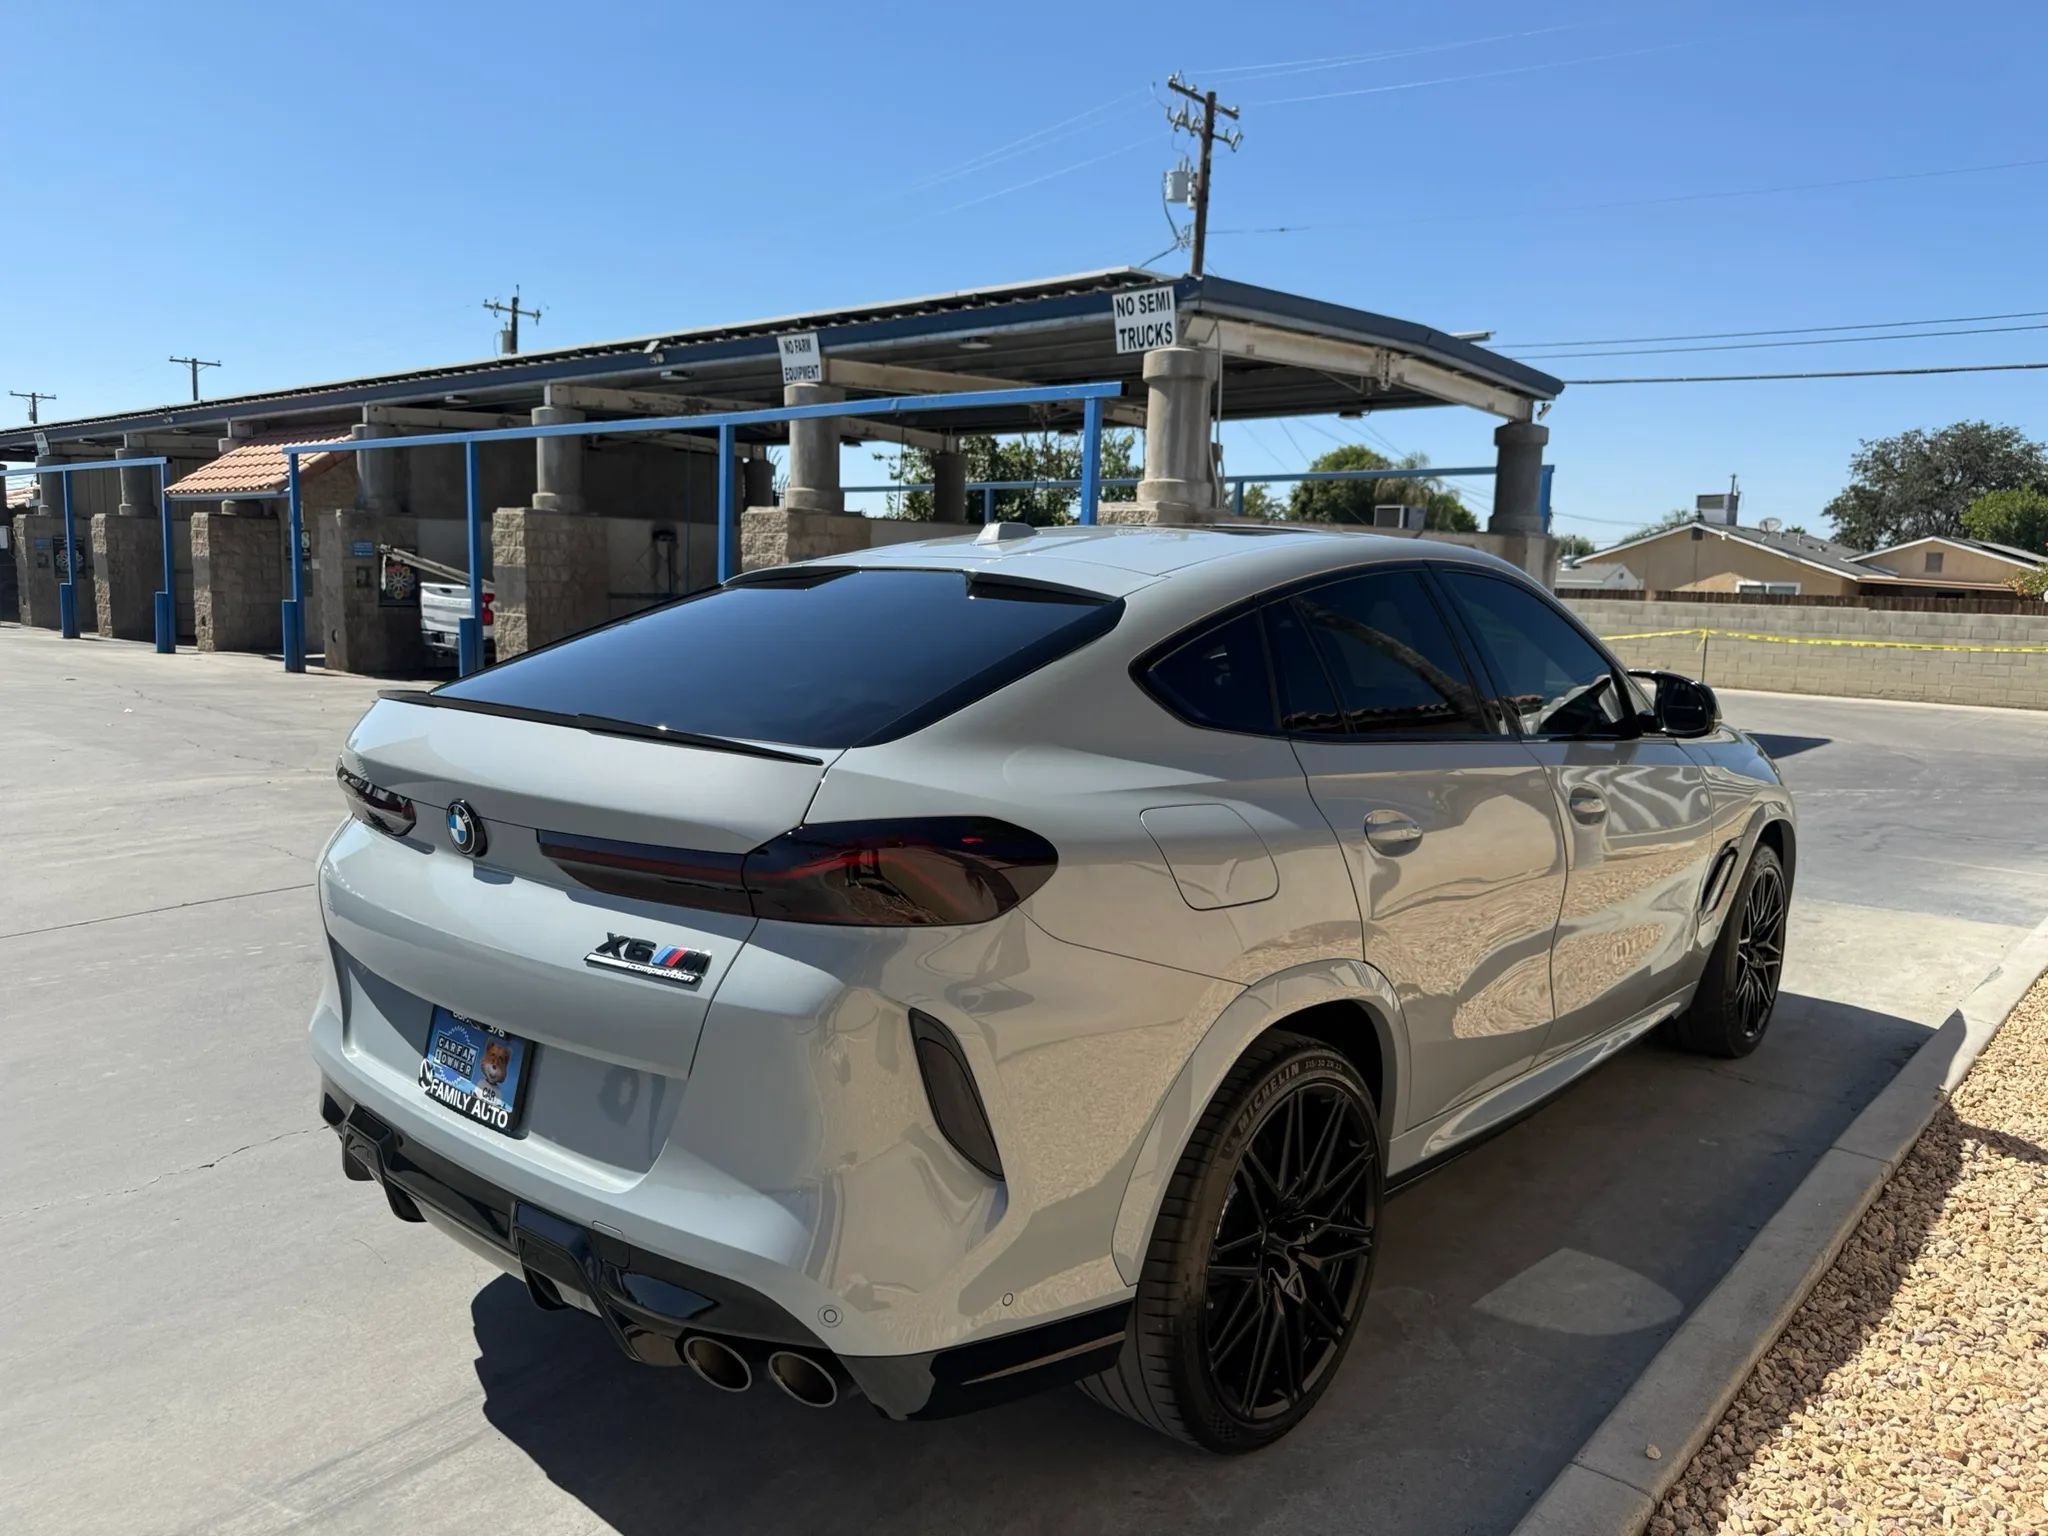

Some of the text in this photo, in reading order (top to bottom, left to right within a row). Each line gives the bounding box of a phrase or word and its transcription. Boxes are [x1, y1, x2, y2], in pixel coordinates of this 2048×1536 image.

[1116, 290, 1171, 318] NO SEMI
[783, 338, 812, 354] NO FARM
[1119, 321, 1173, 351] TRUCKS
[784, 365, 819, 381] EQUIPMENT
[595, 931, 657, 963] X6
[628, 962, 695, 982] competition
[438, 1037, 475, 1063] CARFAX
[430, 1079, 509, 1128] FAMILY AUTO
[482, 1086, 496, 1102] CAR
[1237, 1062, 1300, 1134] MICHELIN
